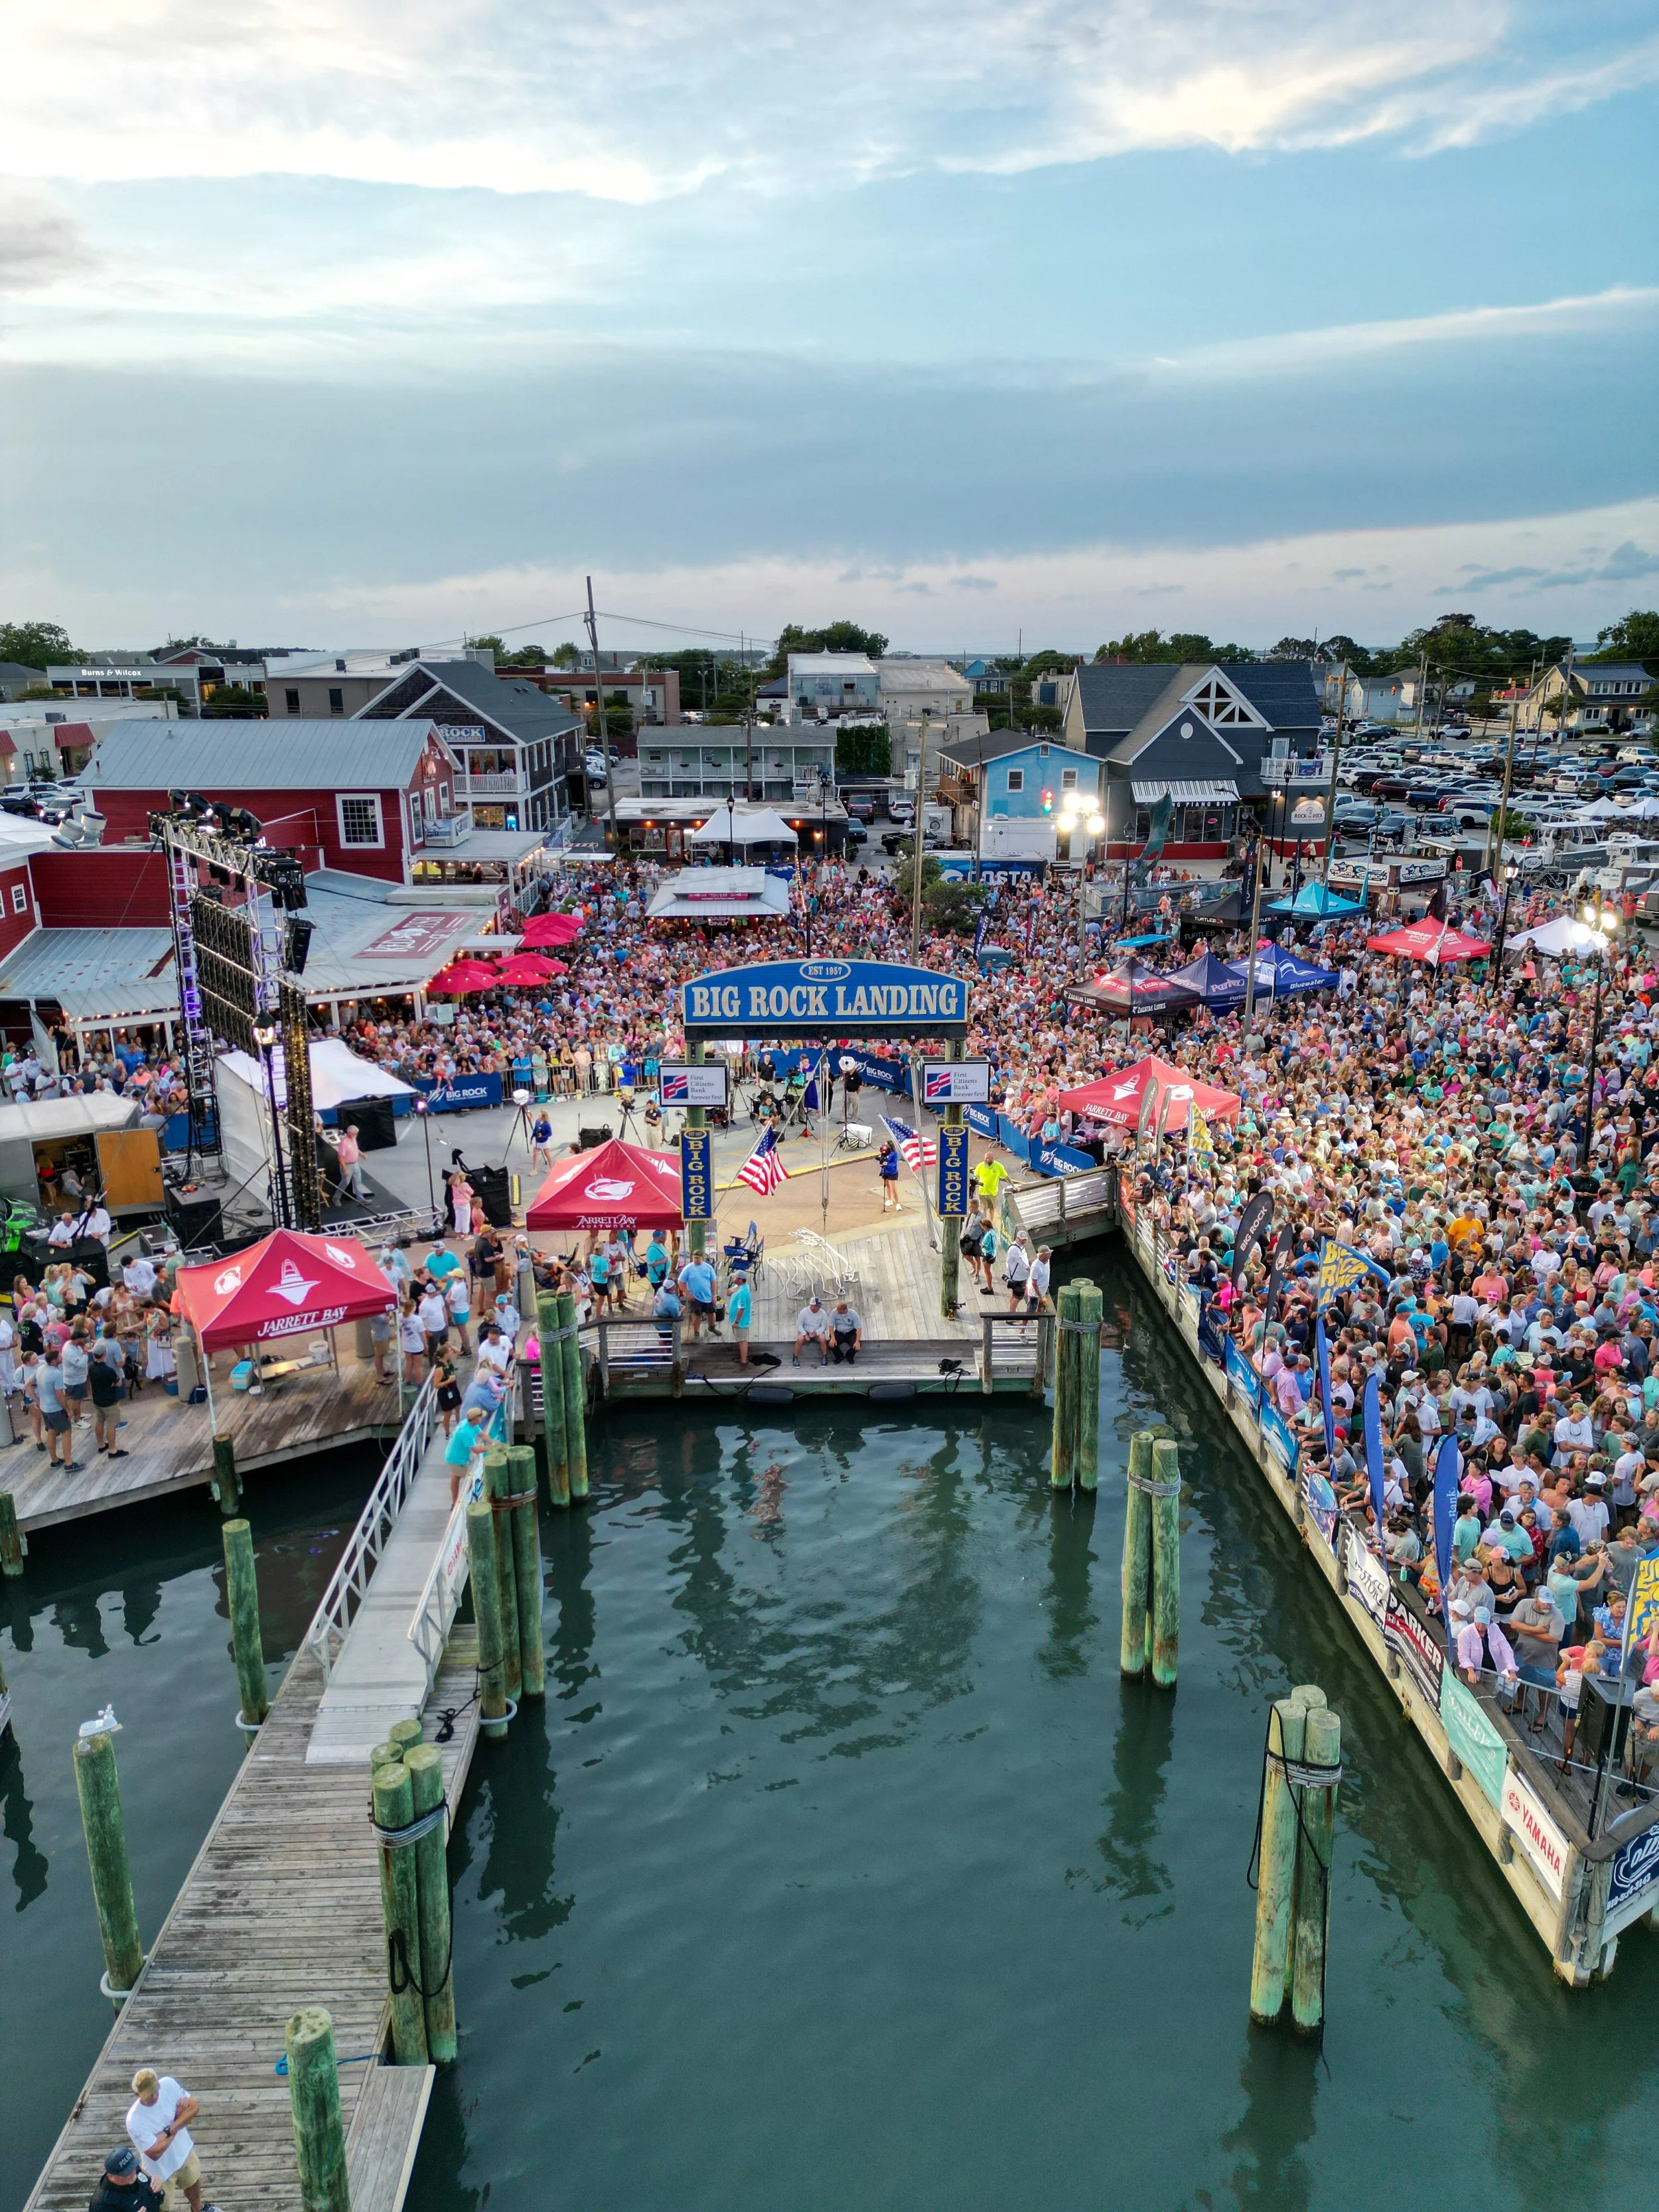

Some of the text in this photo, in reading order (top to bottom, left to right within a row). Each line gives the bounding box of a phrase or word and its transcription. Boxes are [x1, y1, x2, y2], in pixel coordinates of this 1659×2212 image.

[968, 871, 1033, 887] COSTA
[808, 966, 843, 976] EST 1957
[1290, 979, 1325, 990] Bluewater
[692, 984, 958, 1017] BIG ROCK LANDING
[867, 1067, 877, 1075] BIG
[877, 1069, 893, 1080] ROCK
[463, 1087, 487, 1097] ROCK
[977, 1111, 990, 1124] ROCK
[1082, 1103, 1130, 1123] JARRETT BAY
[1054, 1157, 1063, 1168] BIG
[1063, 1161, 1082, 1173] ROCK
[687, 1141, 706, 1215] BIG ROCK
[944, 1138, 962, 1212] BIG ROCK
[572, 1215, 637, 1228] JARRETT BAY
[1240, 1206, 1267, 1252] BIG ROCK
[257, 1306, 348, 1337] JARRETT BAY
[1389, 1591, 1442, 1673] PARKER
[1522, 1804, 1560, 1877] YAMAHA
